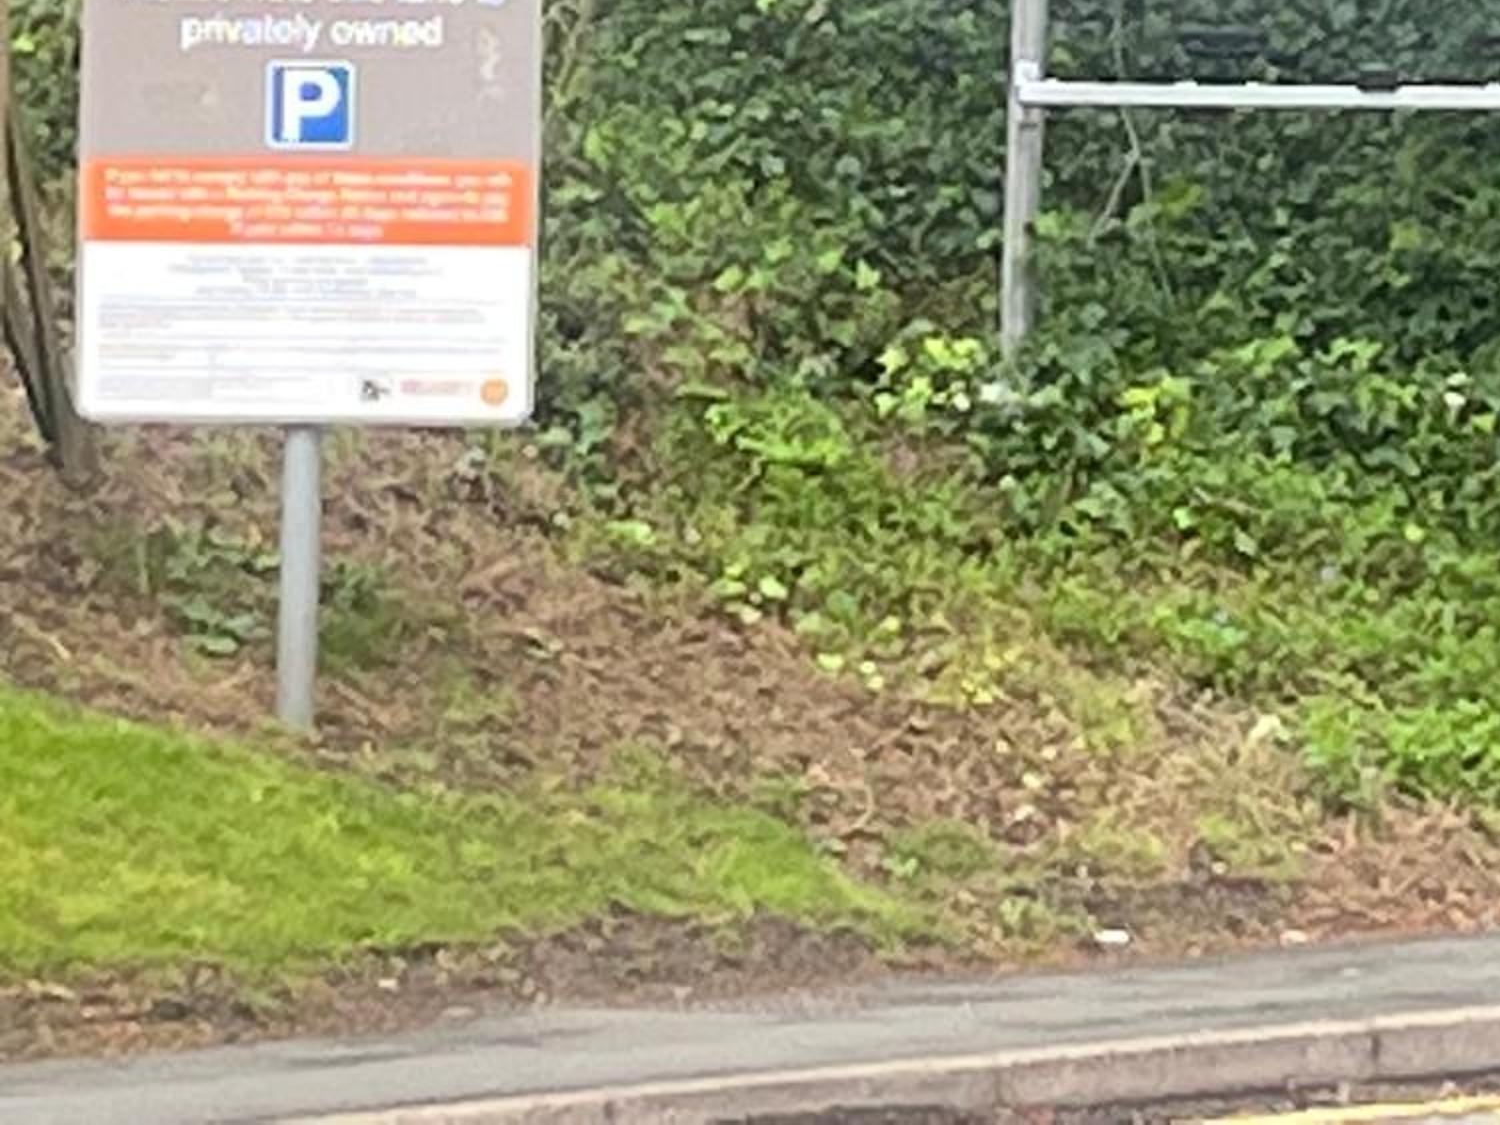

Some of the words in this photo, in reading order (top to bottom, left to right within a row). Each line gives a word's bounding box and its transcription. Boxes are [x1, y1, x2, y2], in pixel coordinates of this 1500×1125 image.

[180, 16, 320, 51] privately
[330, 16, 443, 46] owned
[283, 68, 342, 142] P
